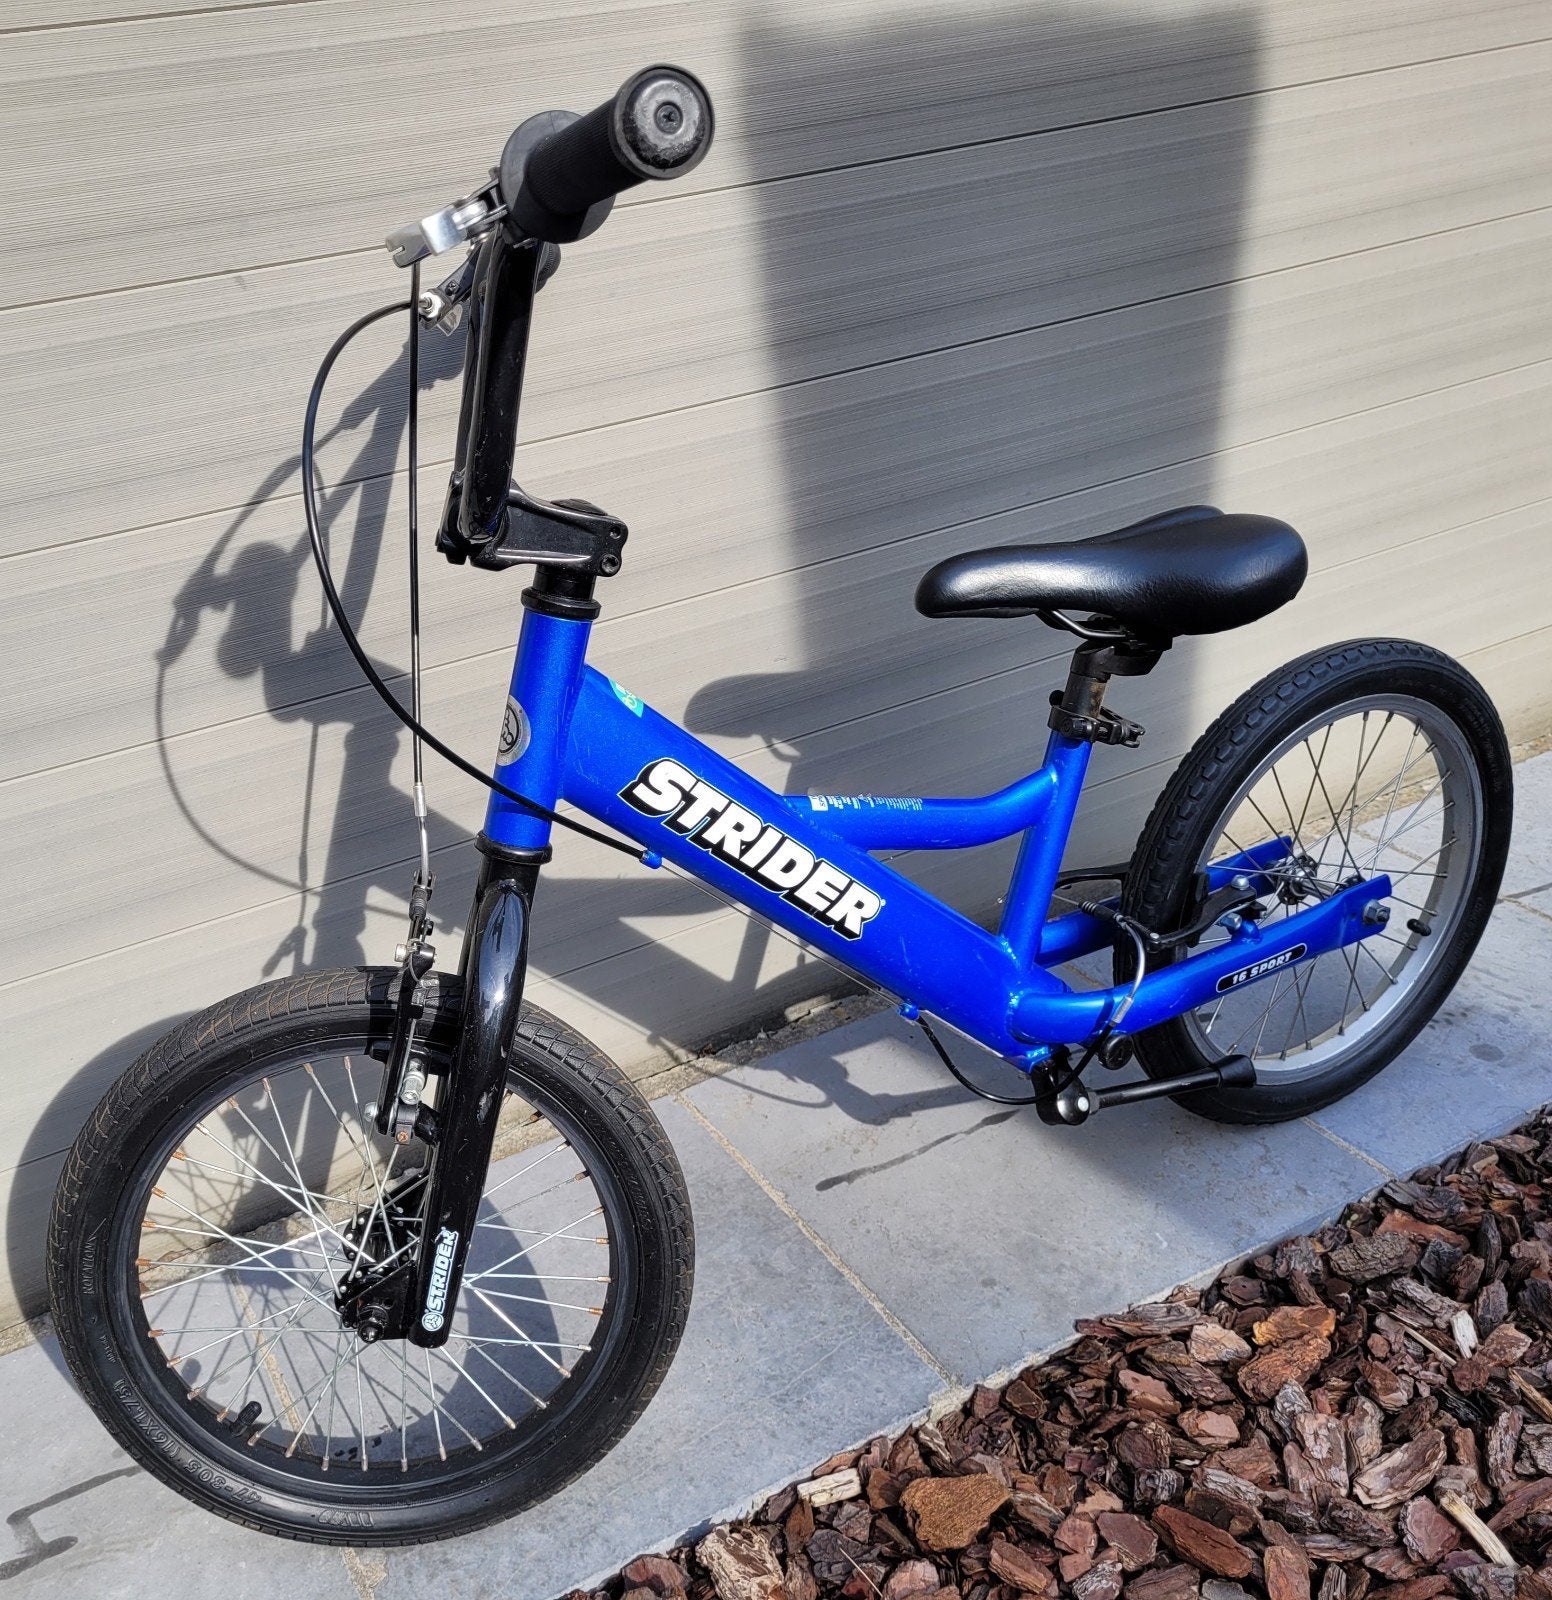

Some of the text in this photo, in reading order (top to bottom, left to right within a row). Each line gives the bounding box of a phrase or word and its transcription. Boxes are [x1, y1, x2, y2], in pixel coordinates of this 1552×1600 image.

[618, 757, 884, 940] STRIDER
[1232, 952, 1293, 985] 16 SPORT
[426, 1229, 459, 1313] STRIDER
[184, 1456, 263, 1504] 47-305
